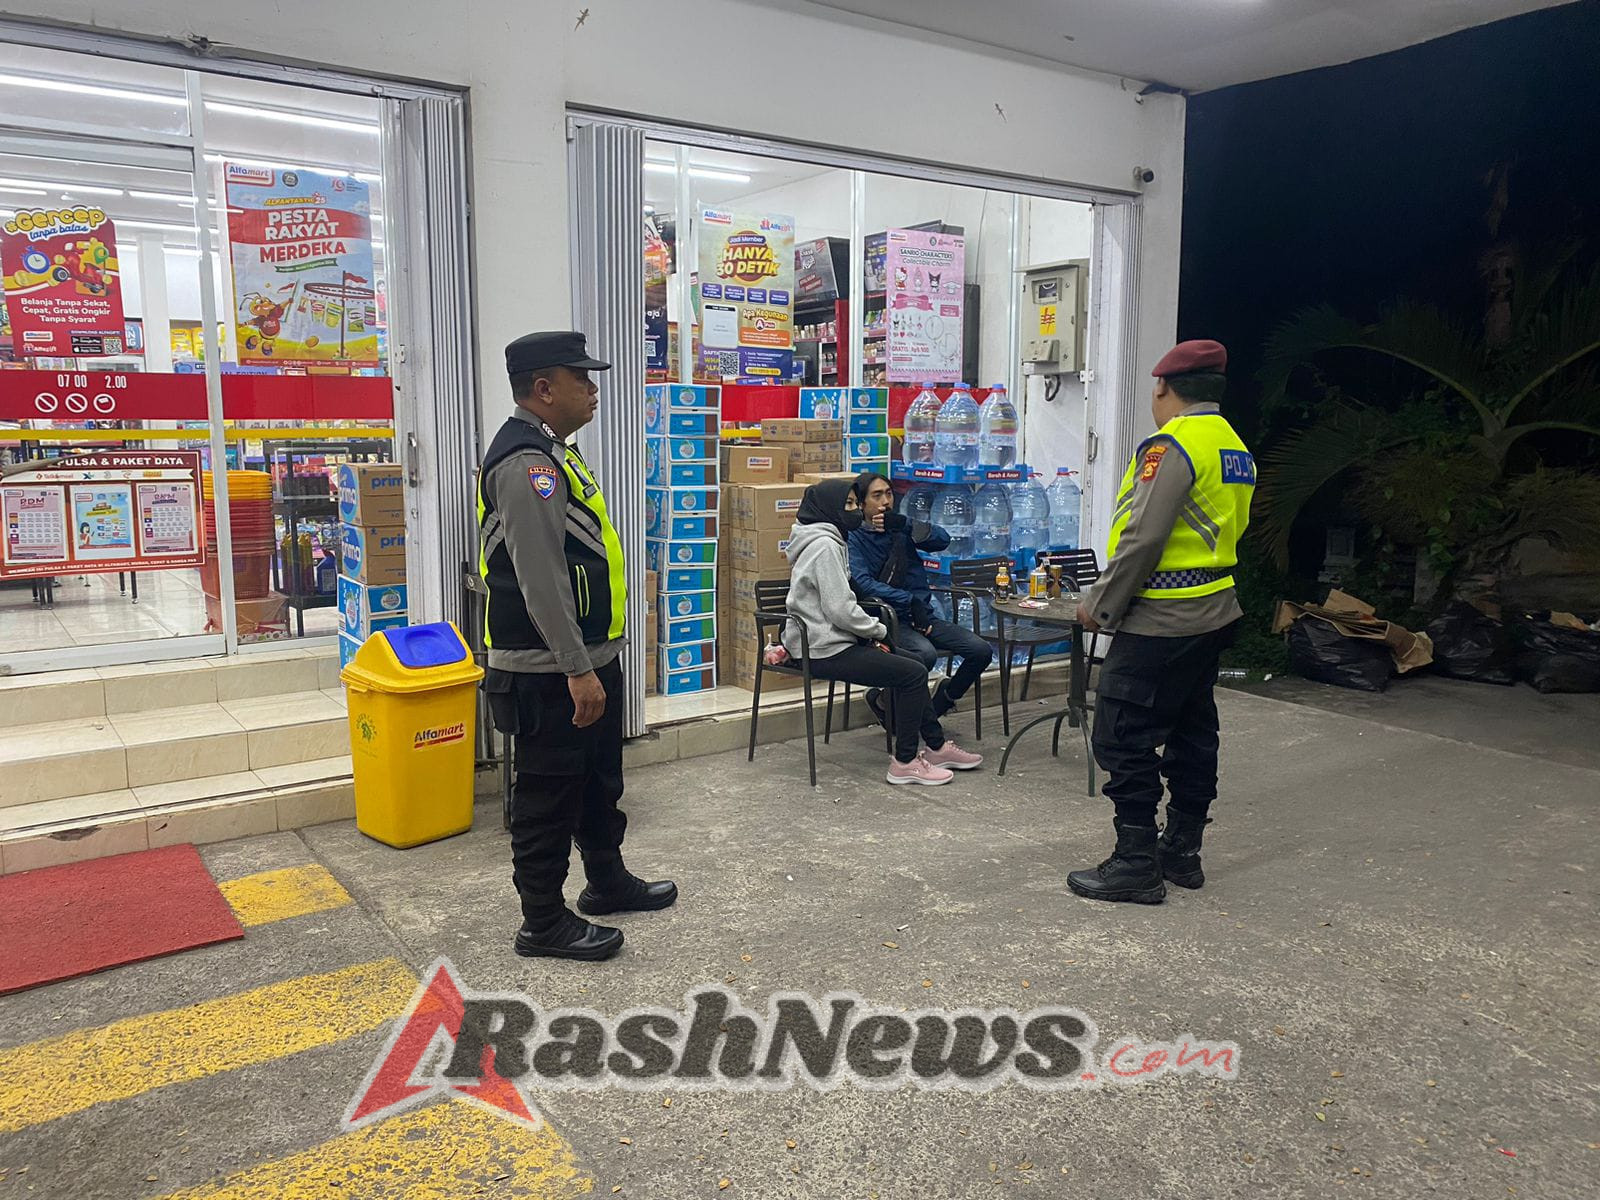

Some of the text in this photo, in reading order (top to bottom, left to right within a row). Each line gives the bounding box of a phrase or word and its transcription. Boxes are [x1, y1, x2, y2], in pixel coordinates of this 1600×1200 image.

[229, 166, 269, 176] Alfamart
[268, 209, 329, 226] PESTA
[704, 210, 731, 220] Alfamart
[265, 222, 339, 240] RAKYAT
[260, 242, 346, 263] MERDEKA
[723, 246, 773, 261] HANYA
[717, 260, 779, 276] 30 DETIK
[20, 298, 111, 307] Belanja Tanpa Sekat,
[23, 307, 51, 315] Cepat,
[81, 308, 111, 316] Ongkir
[743, 308, 788, 320] Apa Kegunaan
[40, 315, 66, 323] Tanpa
[57, 374, 70, 387] 07
[74, 375, 88, 388] 00
[101, 457, 109, 466] &
[113, 457, 151, 466] PAKET
[154, 456, 184, 465] DATA
[381, 534, 405, 549] pri
[414, 723, 464, 743] Alfamart
